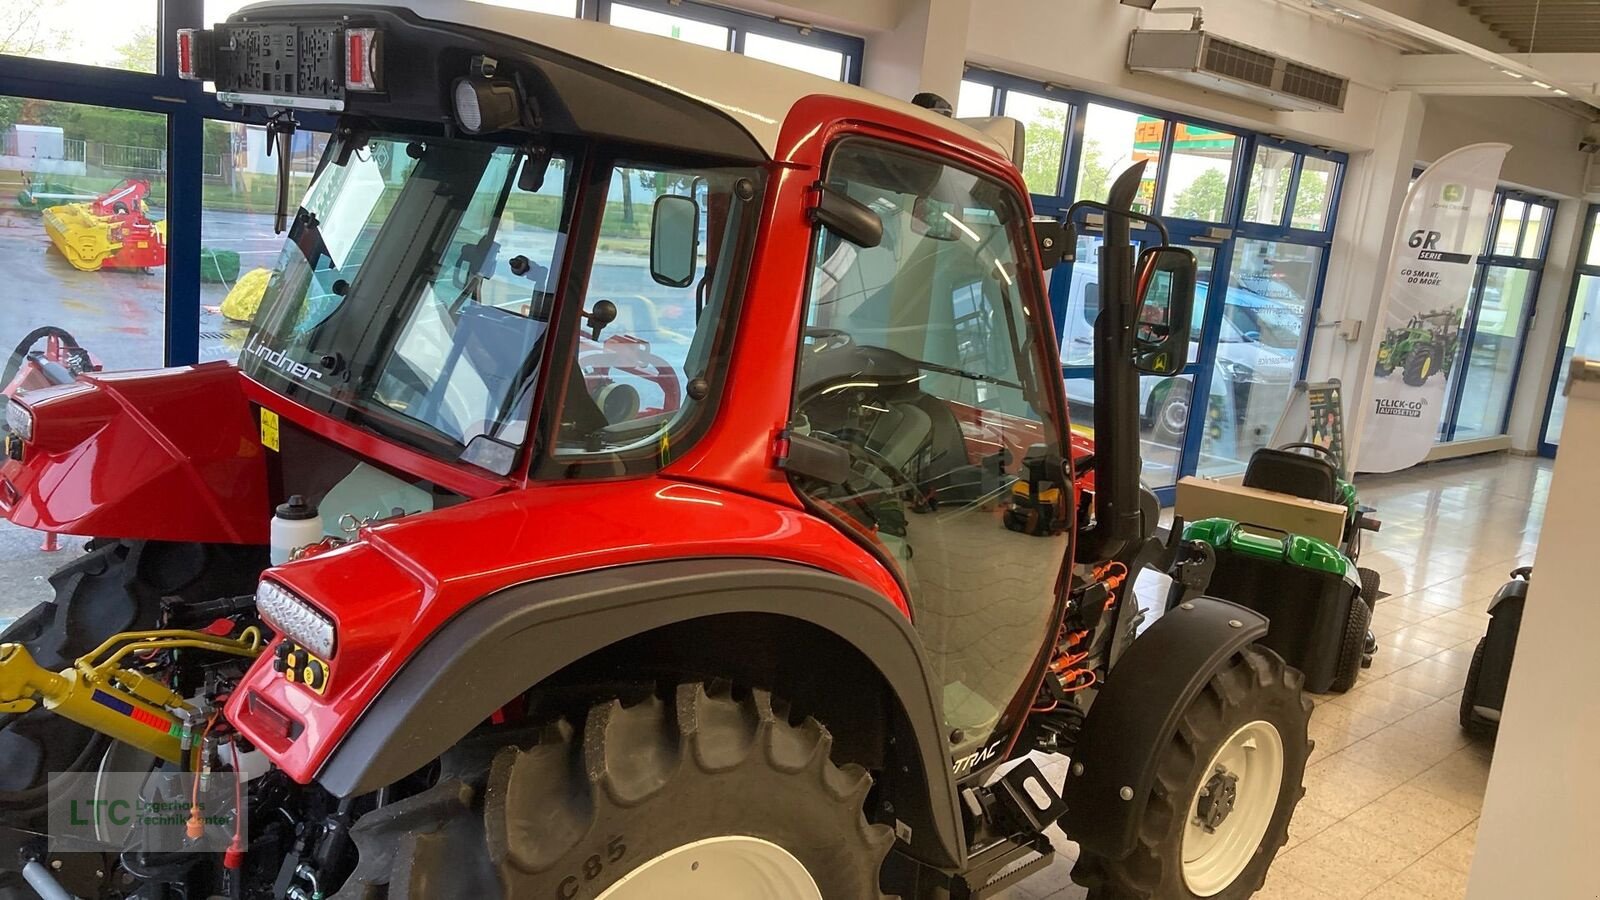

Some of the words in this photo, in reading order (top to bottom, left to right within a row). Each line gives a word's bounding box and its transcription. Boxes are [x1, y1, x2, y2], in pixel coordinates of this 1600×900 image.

[1408, 230, 1441, 250] 6R
[1420, 251, 1442, 260] SERIE
[247, 333, 322, 380] Lindner
[1380, 407, 1420, 417] AUTOSETUP
[953, 740, 1001, 774] TRAC
